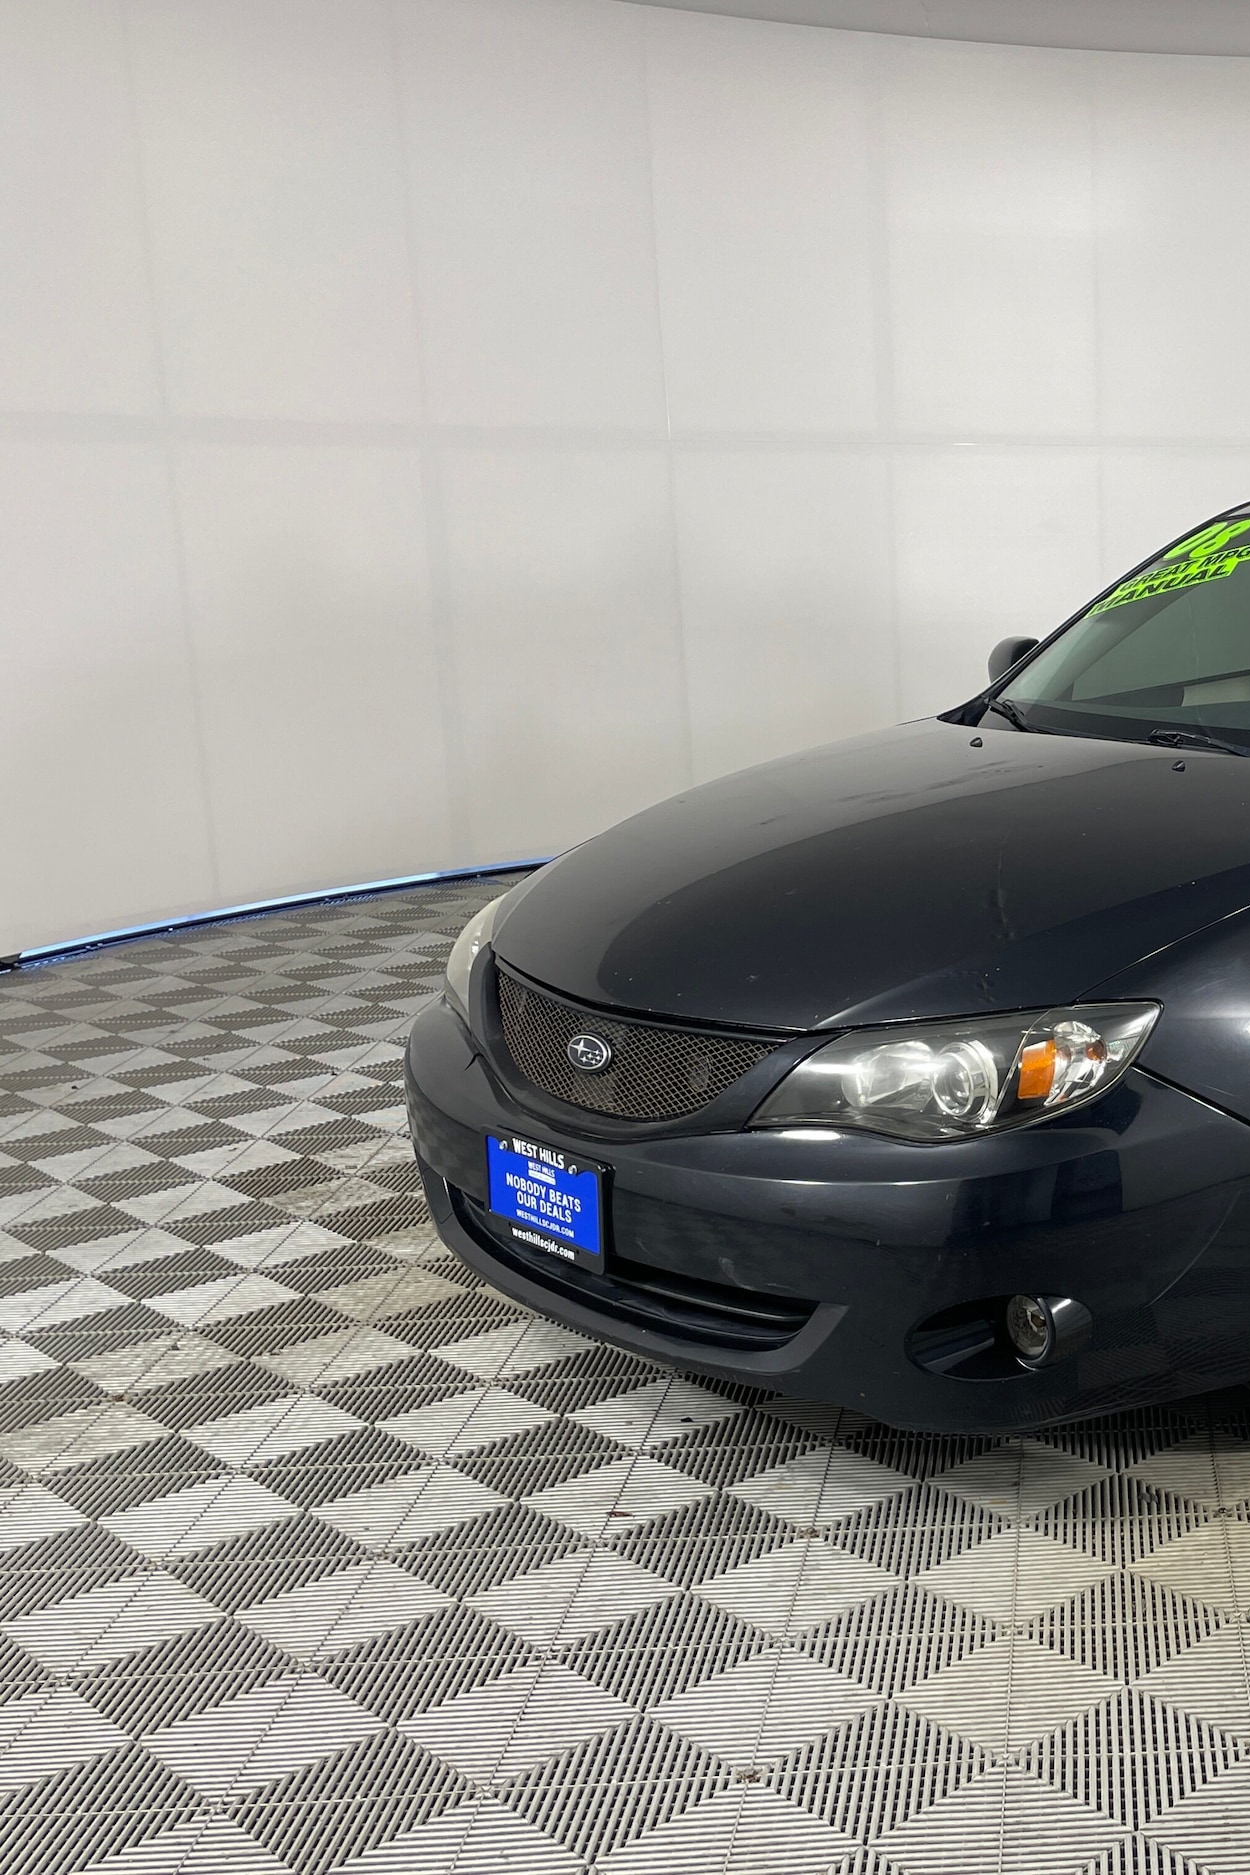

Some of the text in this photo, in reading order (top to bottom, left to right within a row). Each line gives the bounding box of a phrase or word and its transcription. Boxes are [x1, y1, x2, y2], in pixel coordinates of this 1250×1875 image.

[1088, 564, 1230, 616] MANUAL
[1119, 560, 1197, 592] GREAT
[512, 1138, 565, 1169] WEST HILLS
[528, 1160, 542, 1172] WEST
[506, 1172, 547, 1199] NOBODY
[549, 1189, 582, 1213] BEATS
[516, 1191, 572, 1223] OUR DEALS
[516, 1208, 575, 1238] WESTHILLSCJDR.COM
[512, 1227, 575, 1261] westhillscjdr.com
